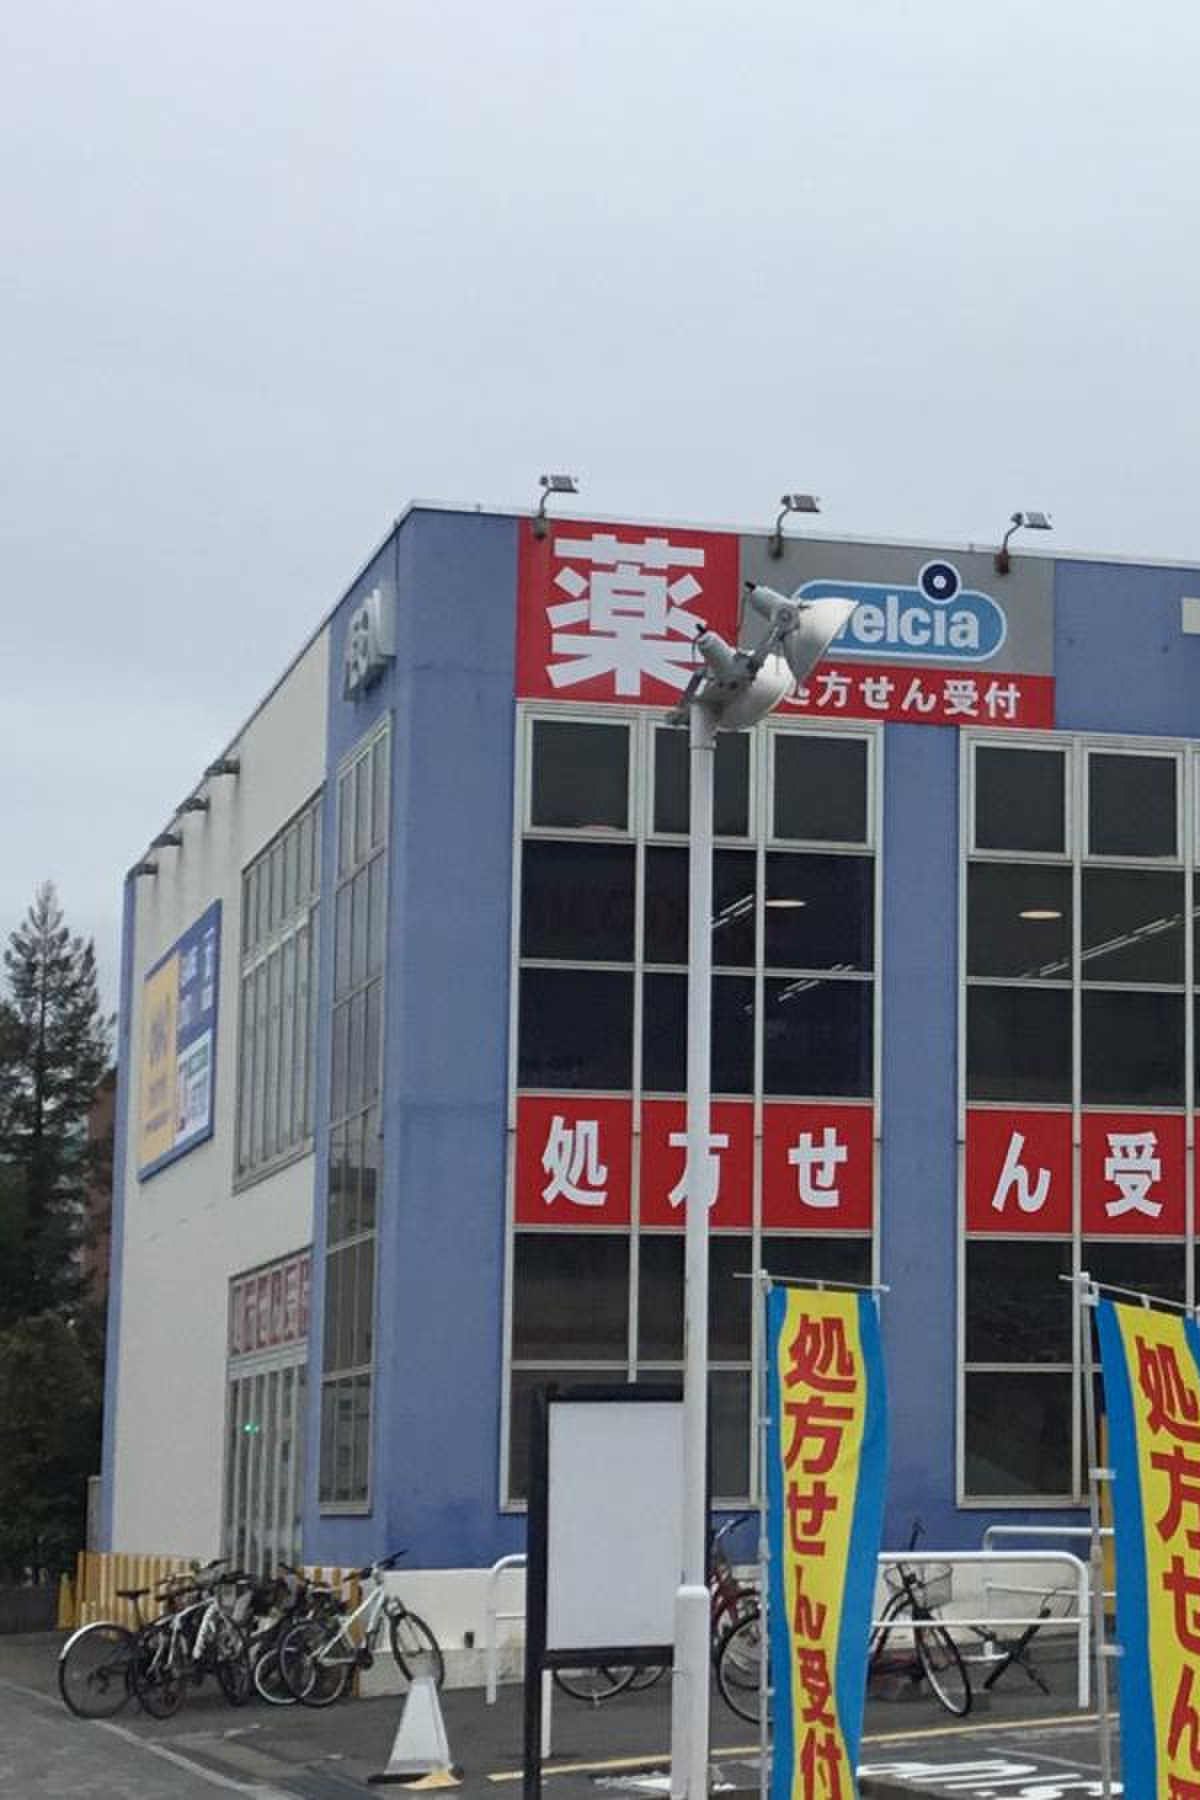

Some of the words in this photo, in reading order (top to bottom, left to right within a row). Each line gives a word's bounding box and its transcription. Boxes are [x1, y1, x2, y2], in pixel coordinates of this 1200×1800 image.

[545, 534, 709, 698] 薬
[838, 594, 980, 649] elcia
[783, 1314, 857, 1800] 処方せん受付
